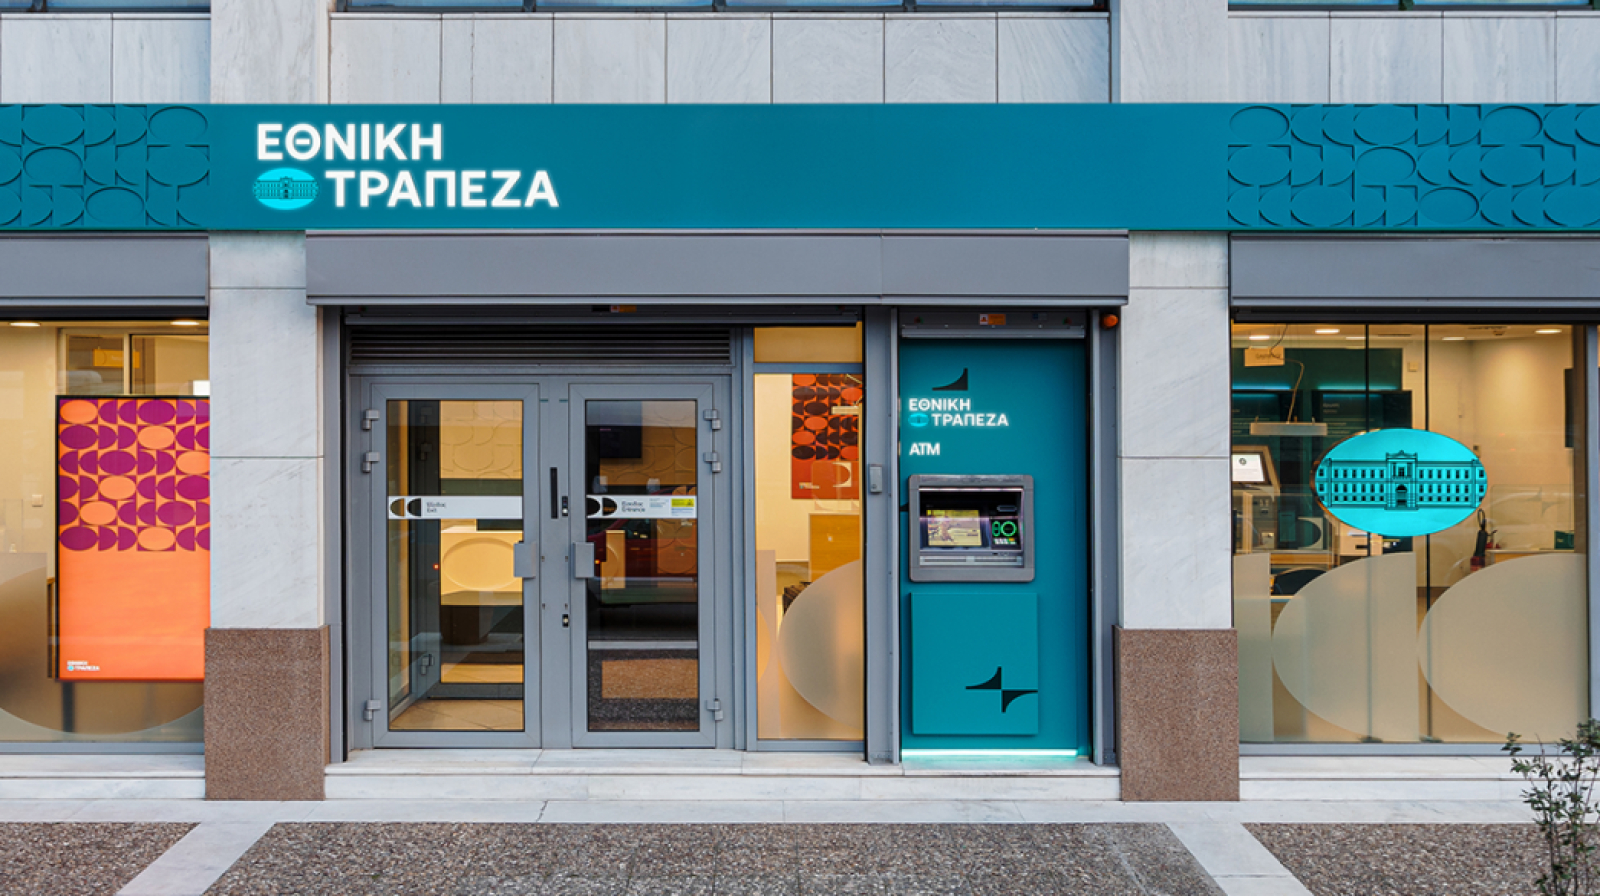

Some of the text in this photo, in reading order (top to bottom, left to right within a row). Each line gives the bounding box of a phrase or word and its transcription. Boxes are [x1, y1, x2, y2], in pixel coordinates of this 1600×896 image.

[257, 123, 442, 161] ΕΘΝΙΚΗ
[325, 170, 560, 208] ΤΡΑΠΕΖΑ
[908, 397, 971, 411] ΕΘΝΙΚΗ
[931, 413, 1009, 427] ΤΡΑΠΕΖΑ
[909, 442, 941, 456] ATM
